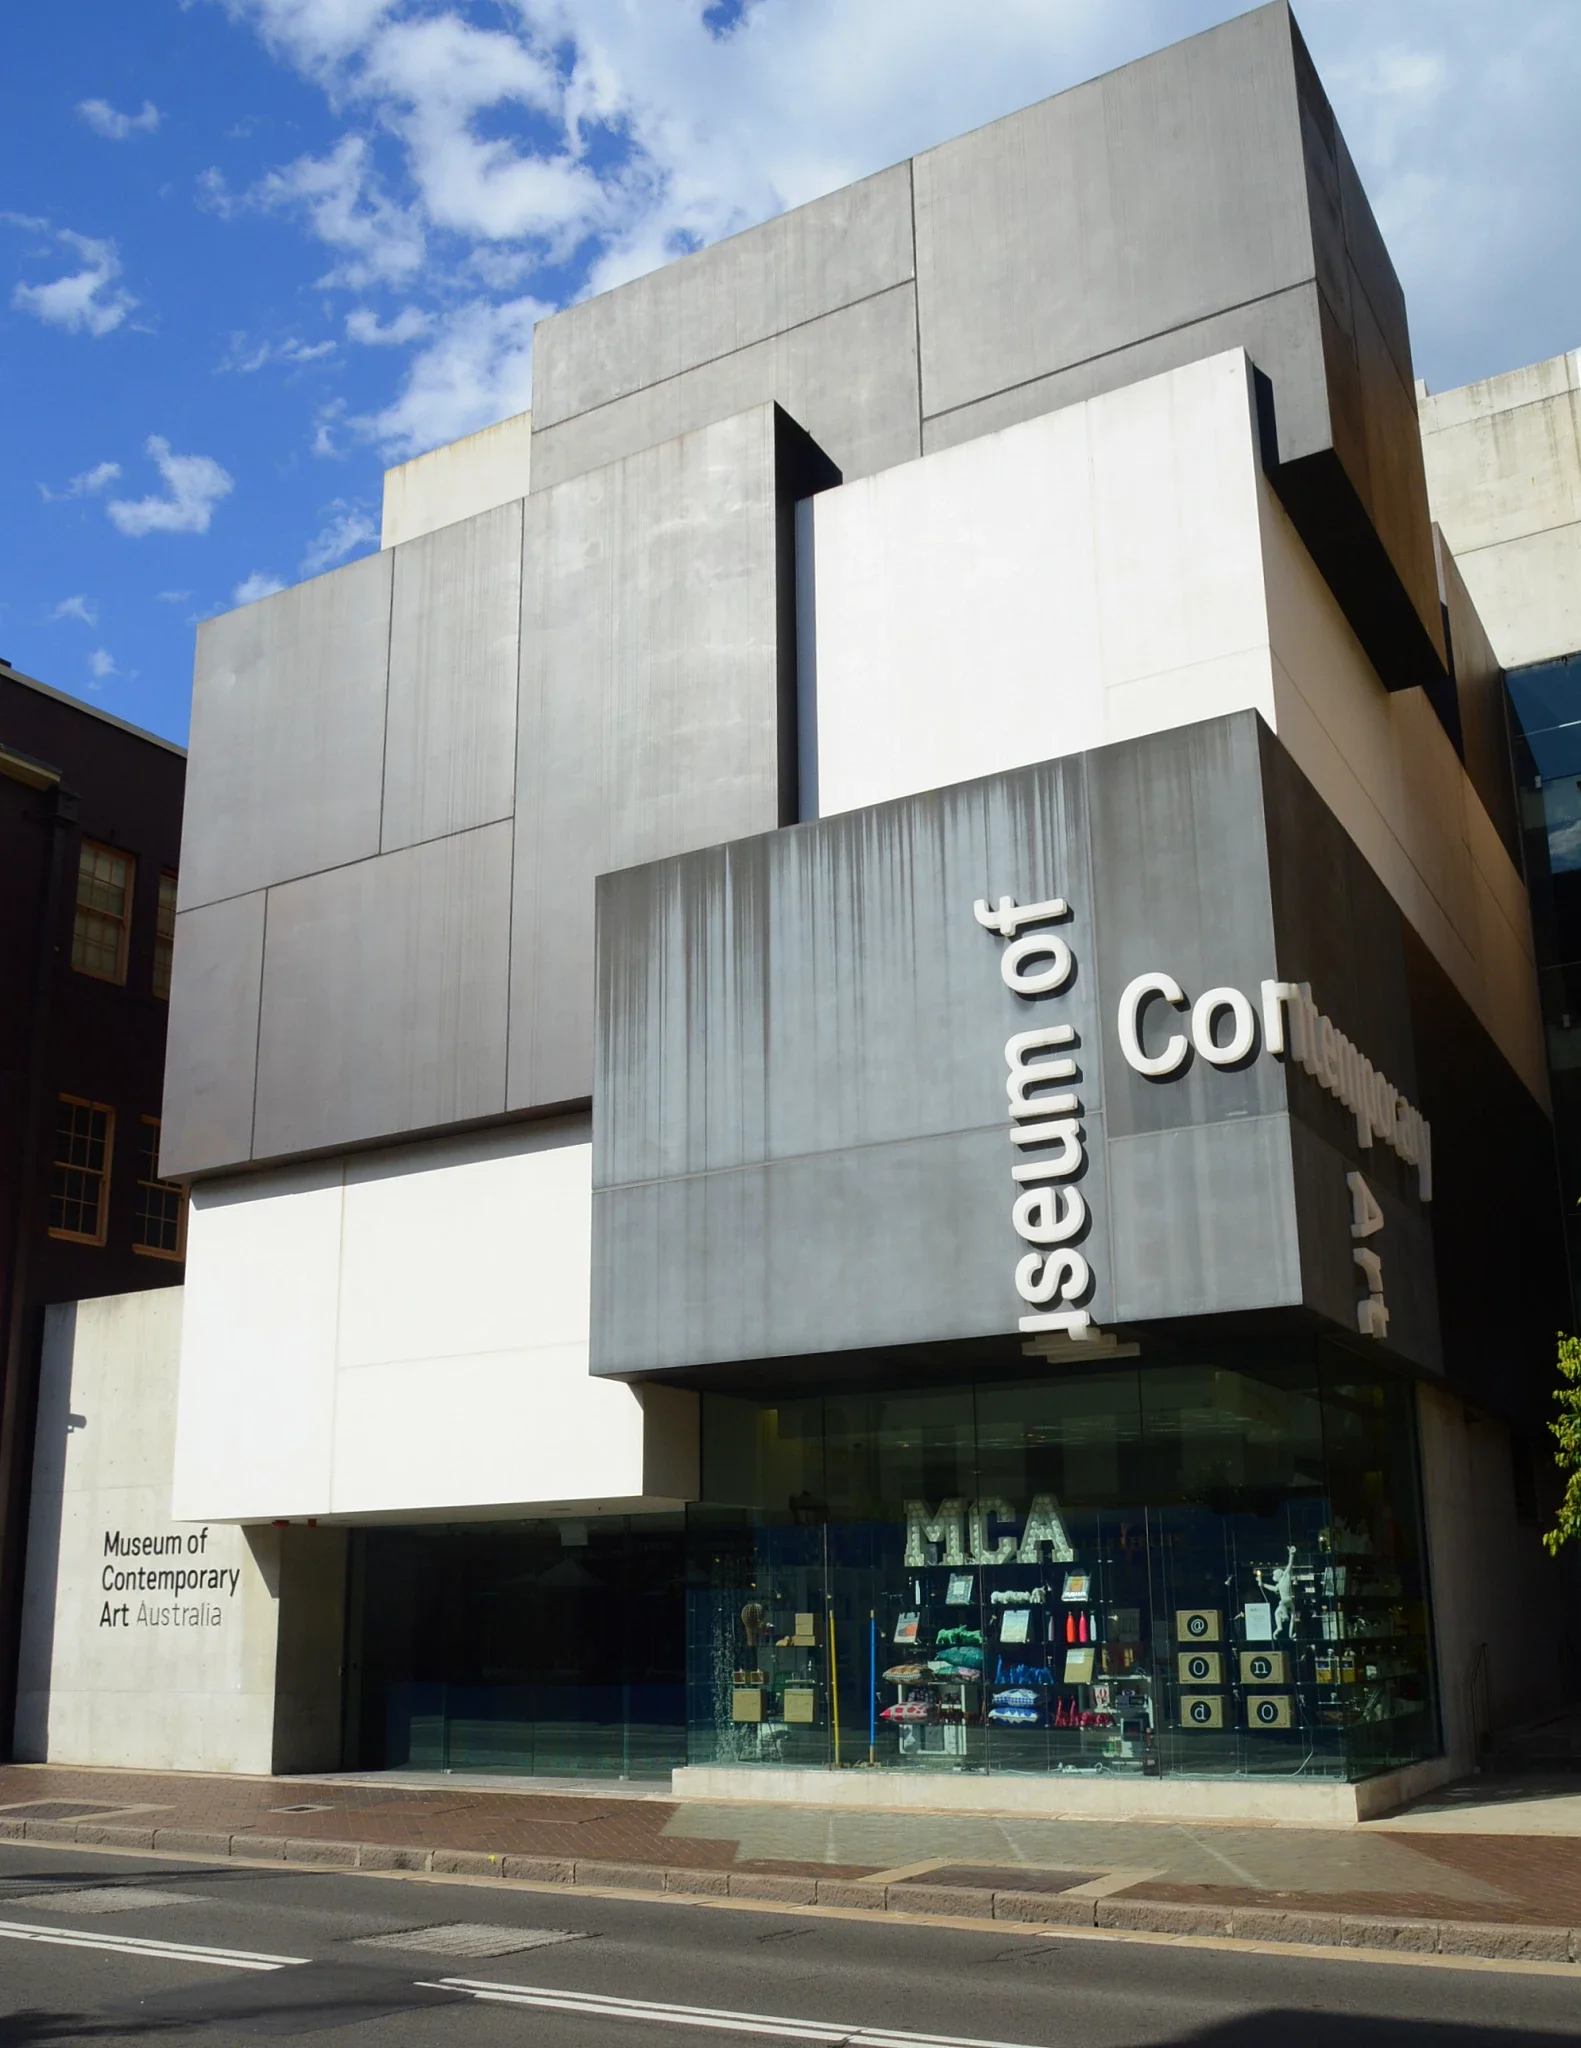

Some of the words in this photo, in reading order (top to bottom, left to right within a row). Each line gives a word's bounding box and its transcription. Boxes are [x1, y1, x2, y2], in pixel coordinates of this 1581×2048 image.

[974, 895, 1073, 995] of
[1346, 1171, 1389, 1339] Art
[103, 1530, 182, 1557] Museum
[187, 1527, 209, 1554] of
[904, 1494, 1078, 1567] MCA
[102, 1564, 240, 1598] Contemporary
[99, 1601, 130, 1627] Art
[136, 1600, 222, 1627] Australia
[1253, 1661, 1268, 1674] n
[1194, 1704, 1207, 1720] d
